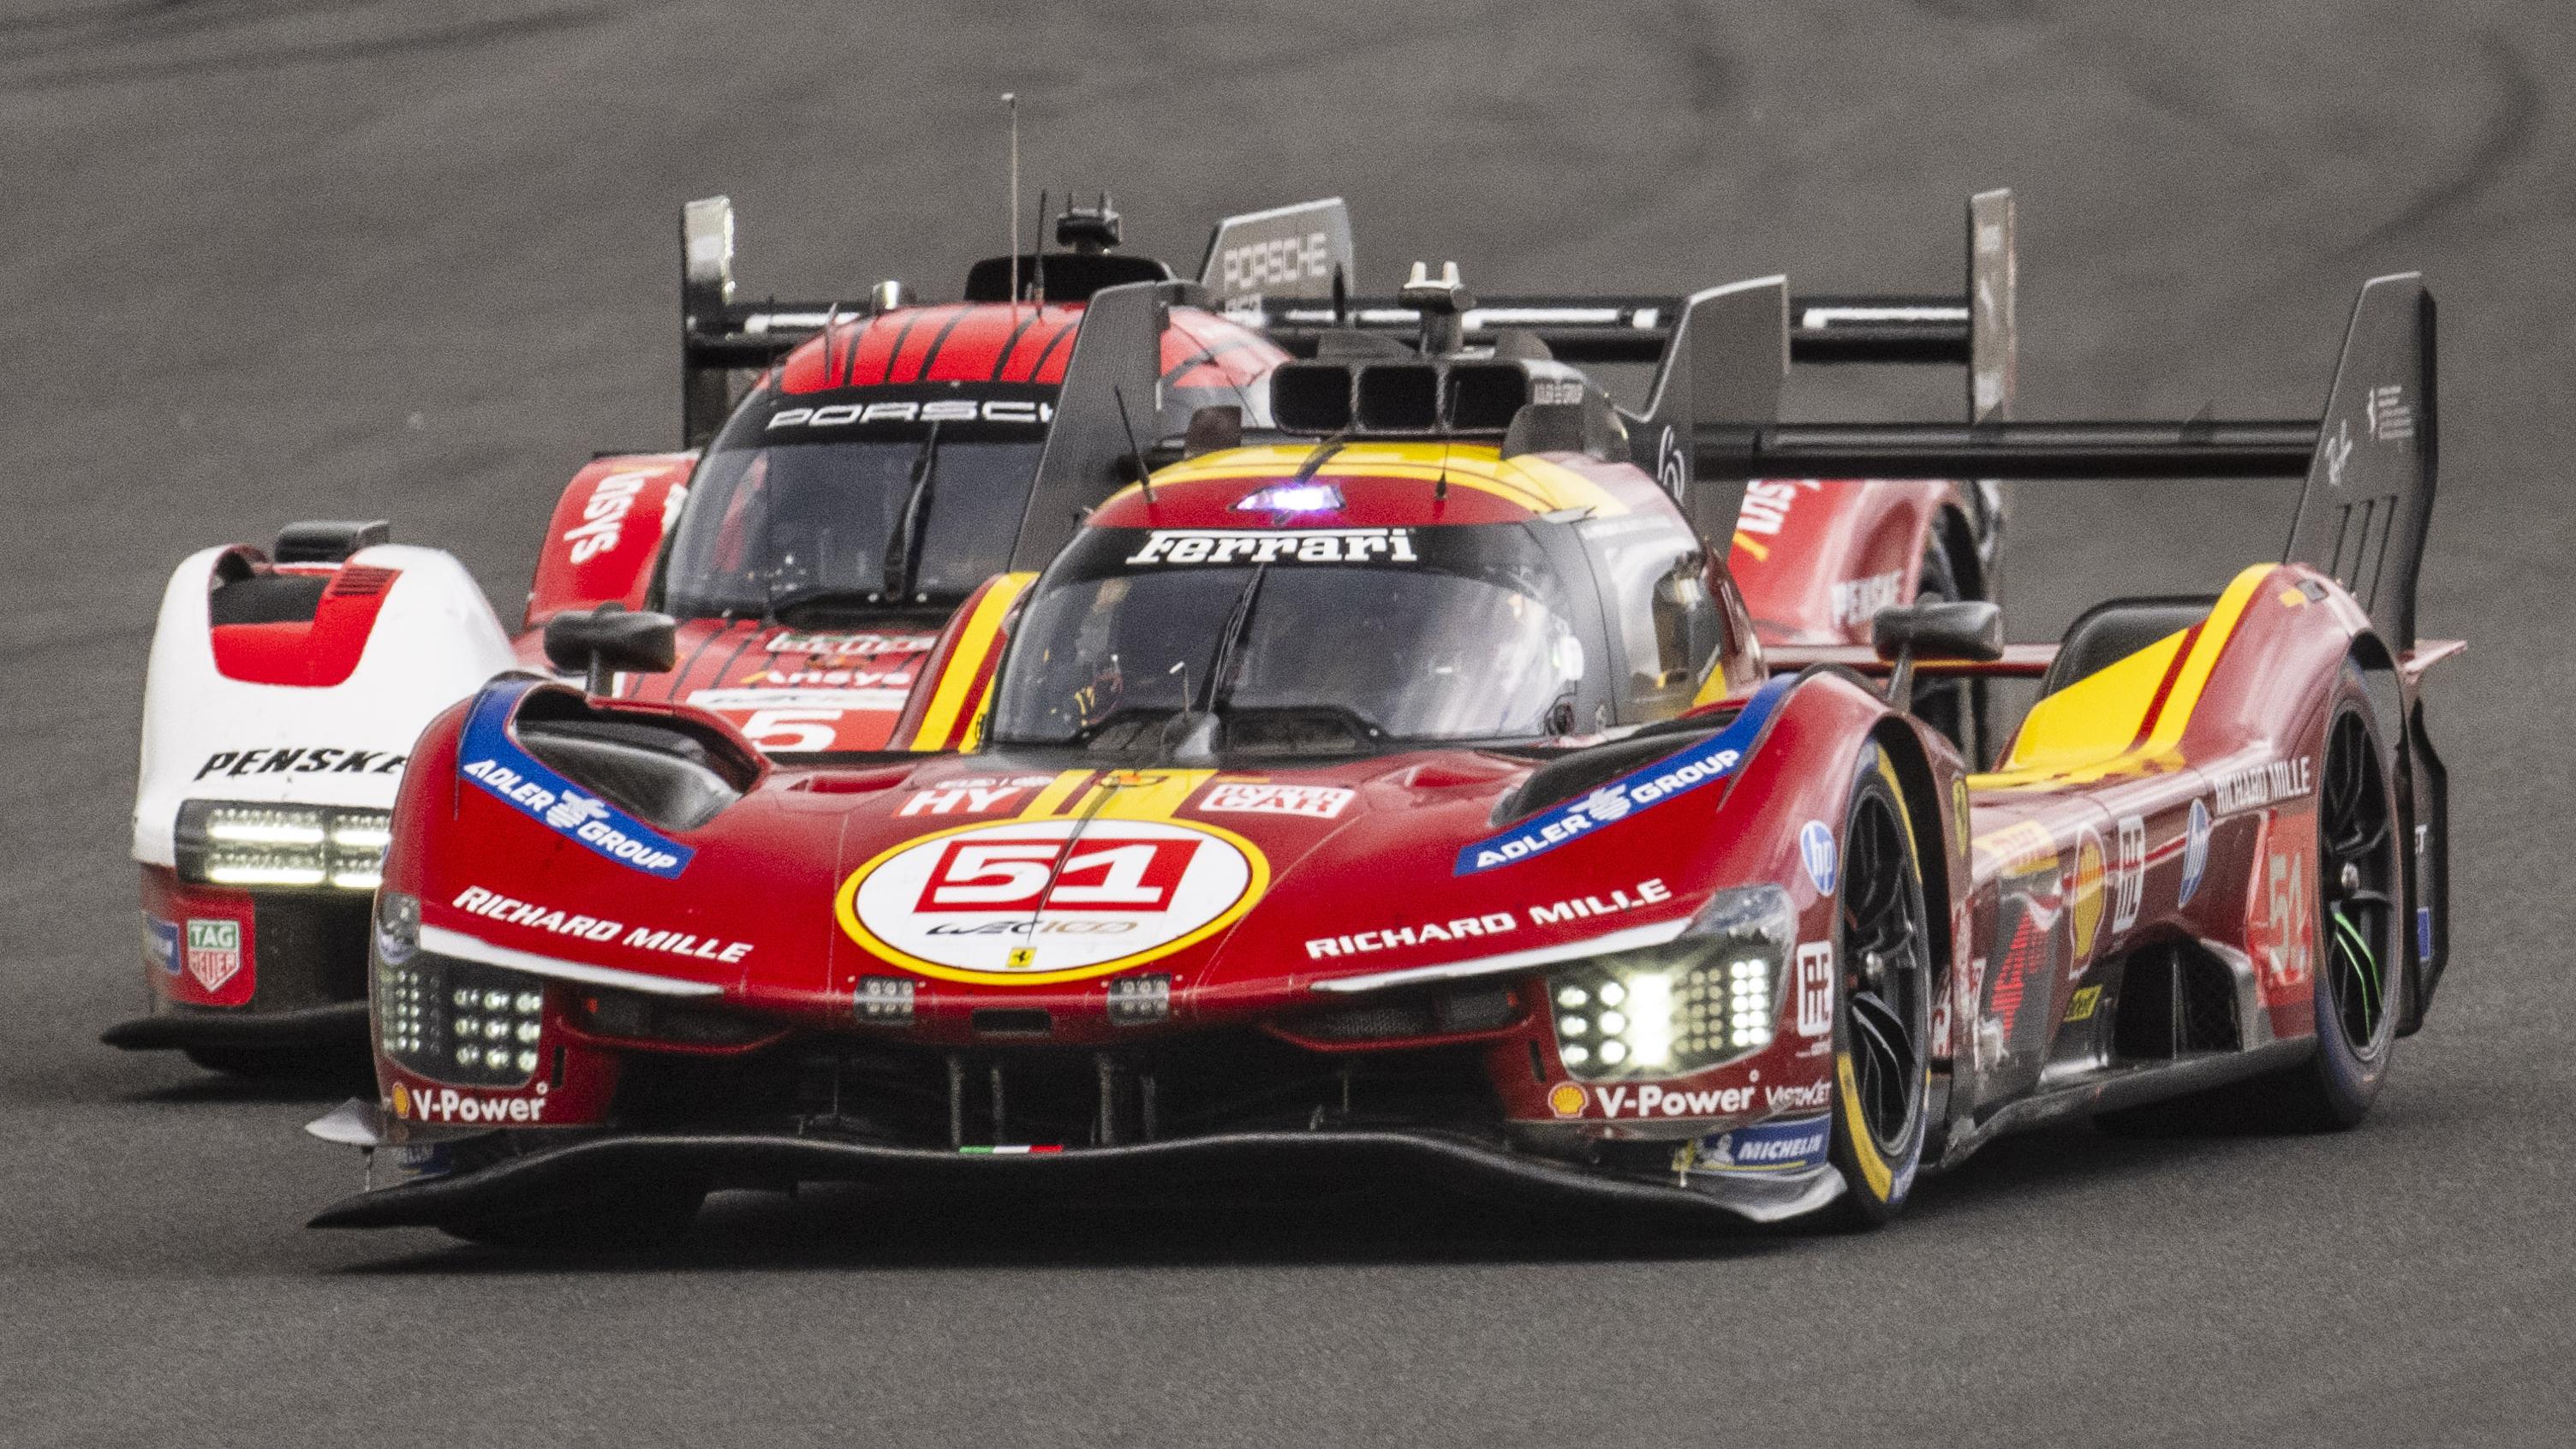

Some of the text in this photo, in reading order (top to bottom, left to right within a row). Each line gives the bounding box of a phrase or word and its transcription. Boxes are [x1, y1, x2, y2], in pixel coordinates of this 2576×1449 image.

[1126, 528, 1418, 565] Ferrari
[741, 708, 837, 753] 5
[463, 759, 678, 872] ADLER GROUP
[1476, 748, 1741, 868] ADLER GROUP
[933, 844, 1167, 904] 51
[190, 925, 235, 947] TAG
[451, 885, 754, 965] RICHARD MILLE
[1304, 877, 1672, 960] RICHARD MILLE
[412, 1088, 546, 1121] V-Power
[1595, 1085, 1756, 1118] V-Power
[1738, 1133, 1823, 1160] MICHELIN
